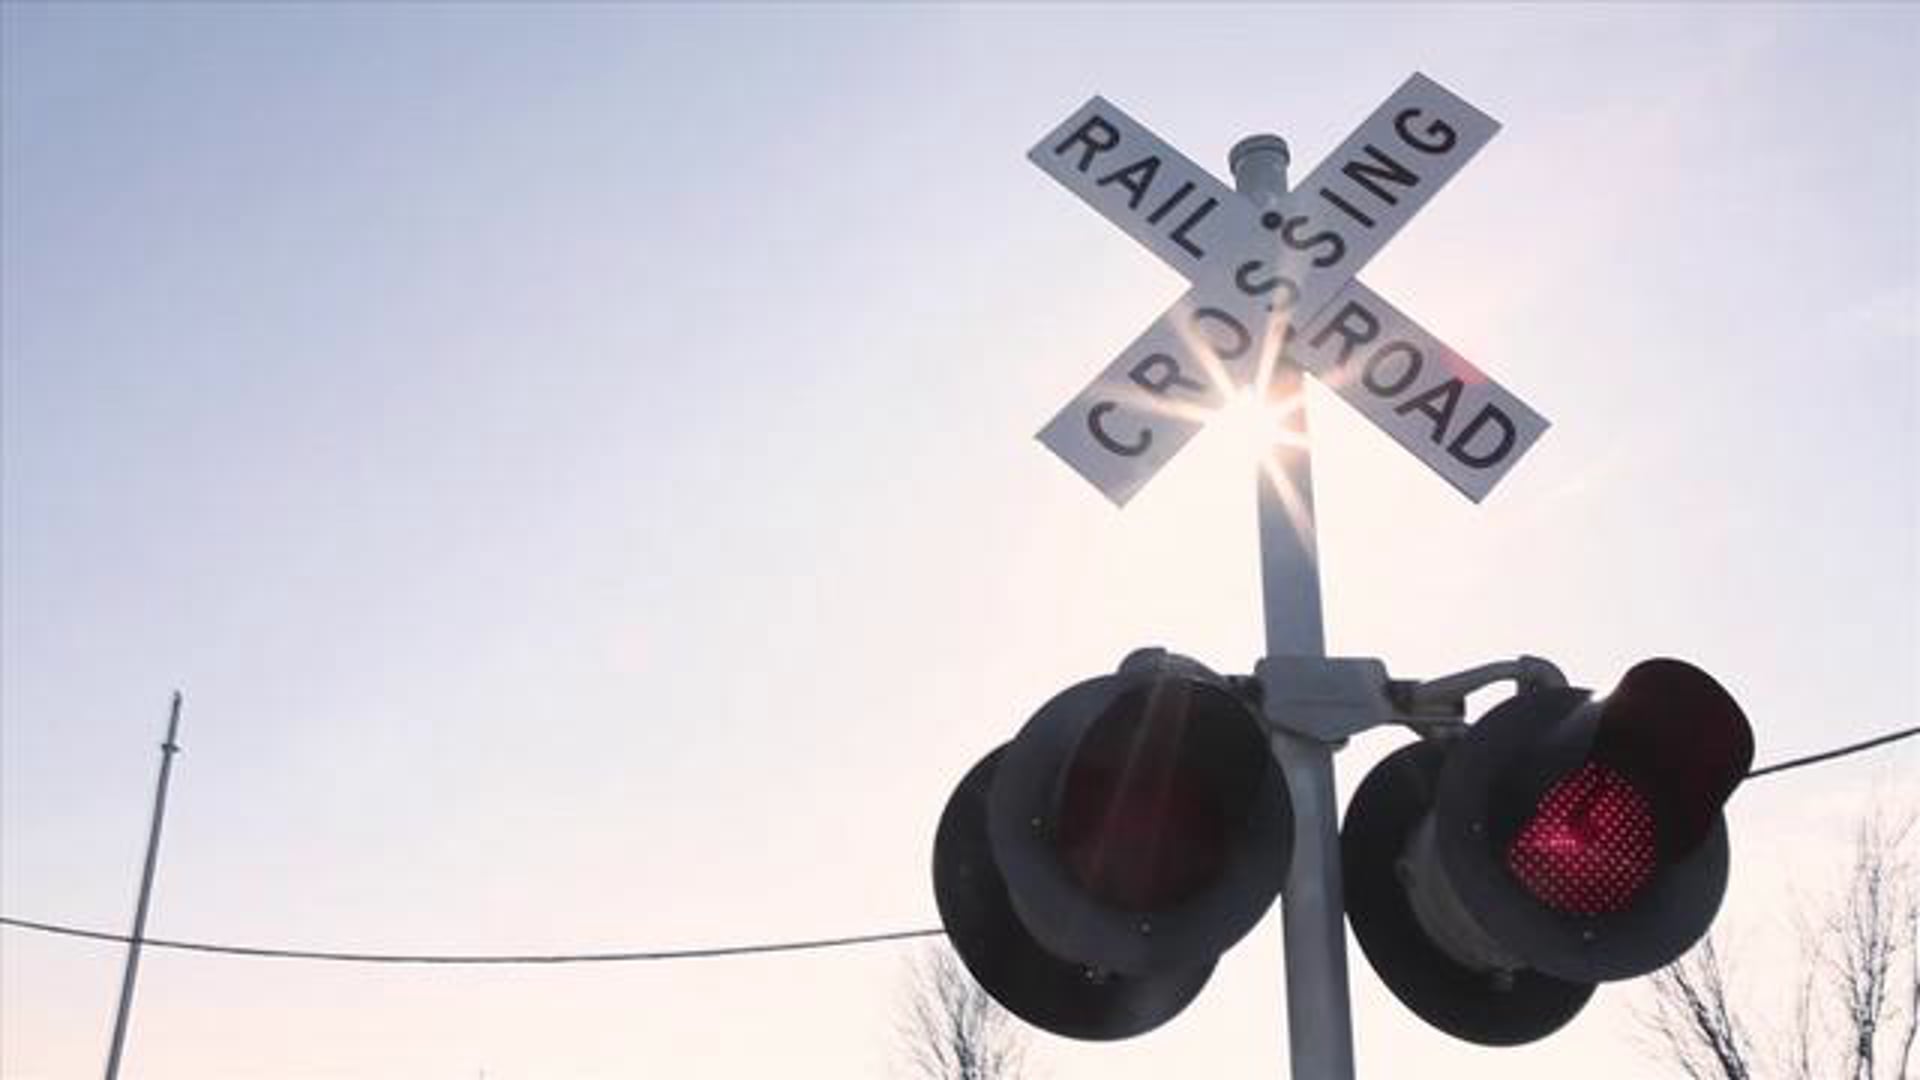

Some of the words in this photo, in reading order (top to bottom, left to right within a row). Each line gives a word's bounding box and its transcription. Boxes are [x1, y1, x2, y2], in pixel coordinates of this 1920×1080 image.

[1054, 115, 1220, 260] RAIL
[1309, 302, 1517, 469] ROAD
[1088, 107, 1457, 457] CROSSING
